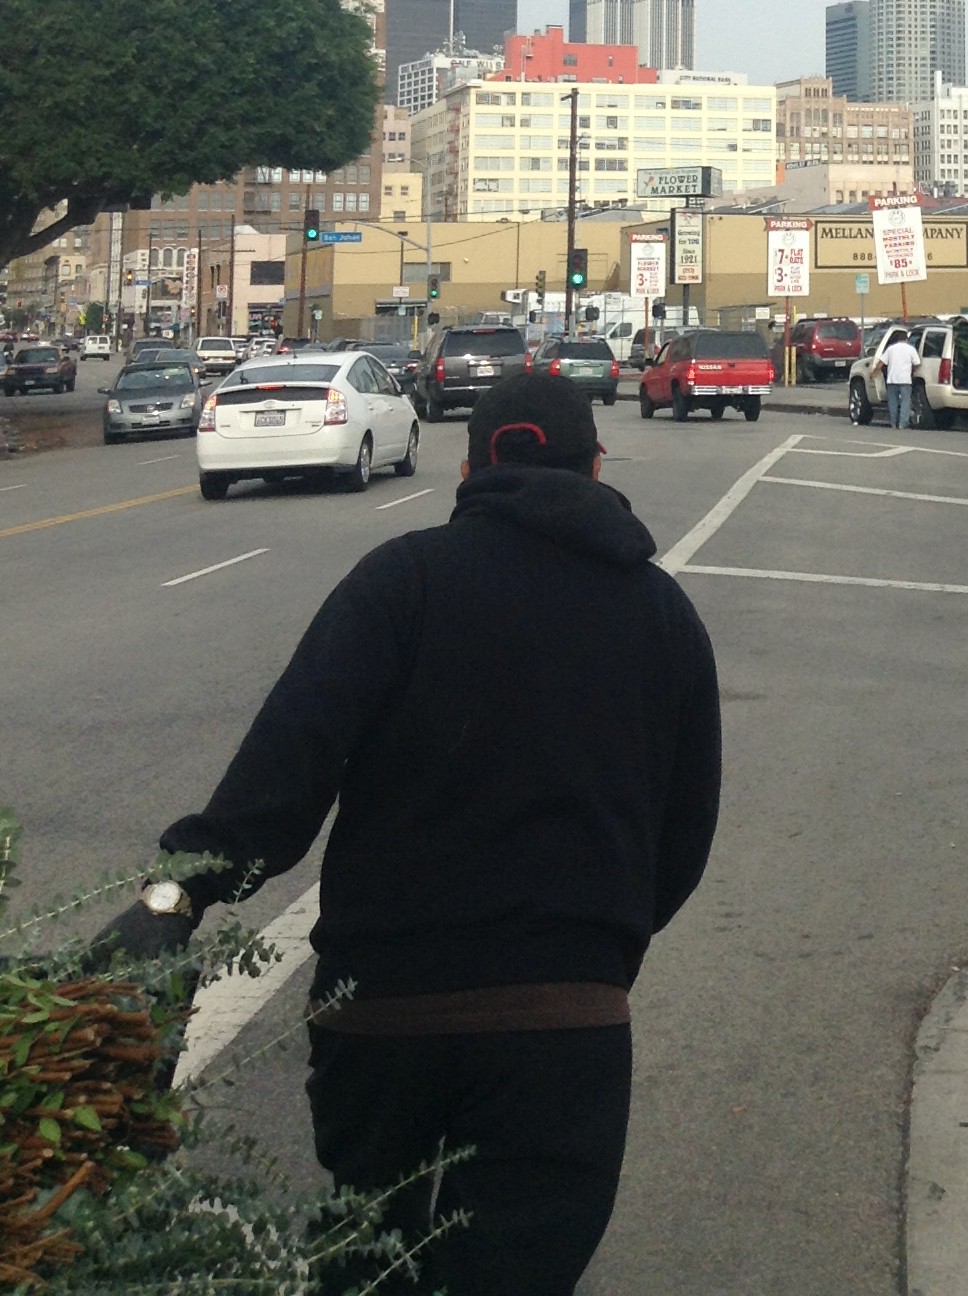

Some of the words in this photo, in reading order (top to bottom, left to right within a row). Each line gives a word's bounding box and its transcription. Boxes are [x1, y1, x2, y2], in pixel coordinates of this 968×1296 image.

[477, 60, 503, 71] WILS
[658, 174, 699, 185] FLOWER
[650, 184, 698, 195] MARKET
[874, 195, 918, 207] PARKING
[770, 220, 808, 228] PARKING
[820, 227, 874, 240] MELLAN
[882, 227, 914, 236] SPECIAL
[680, 254, 698, 264] 1921
